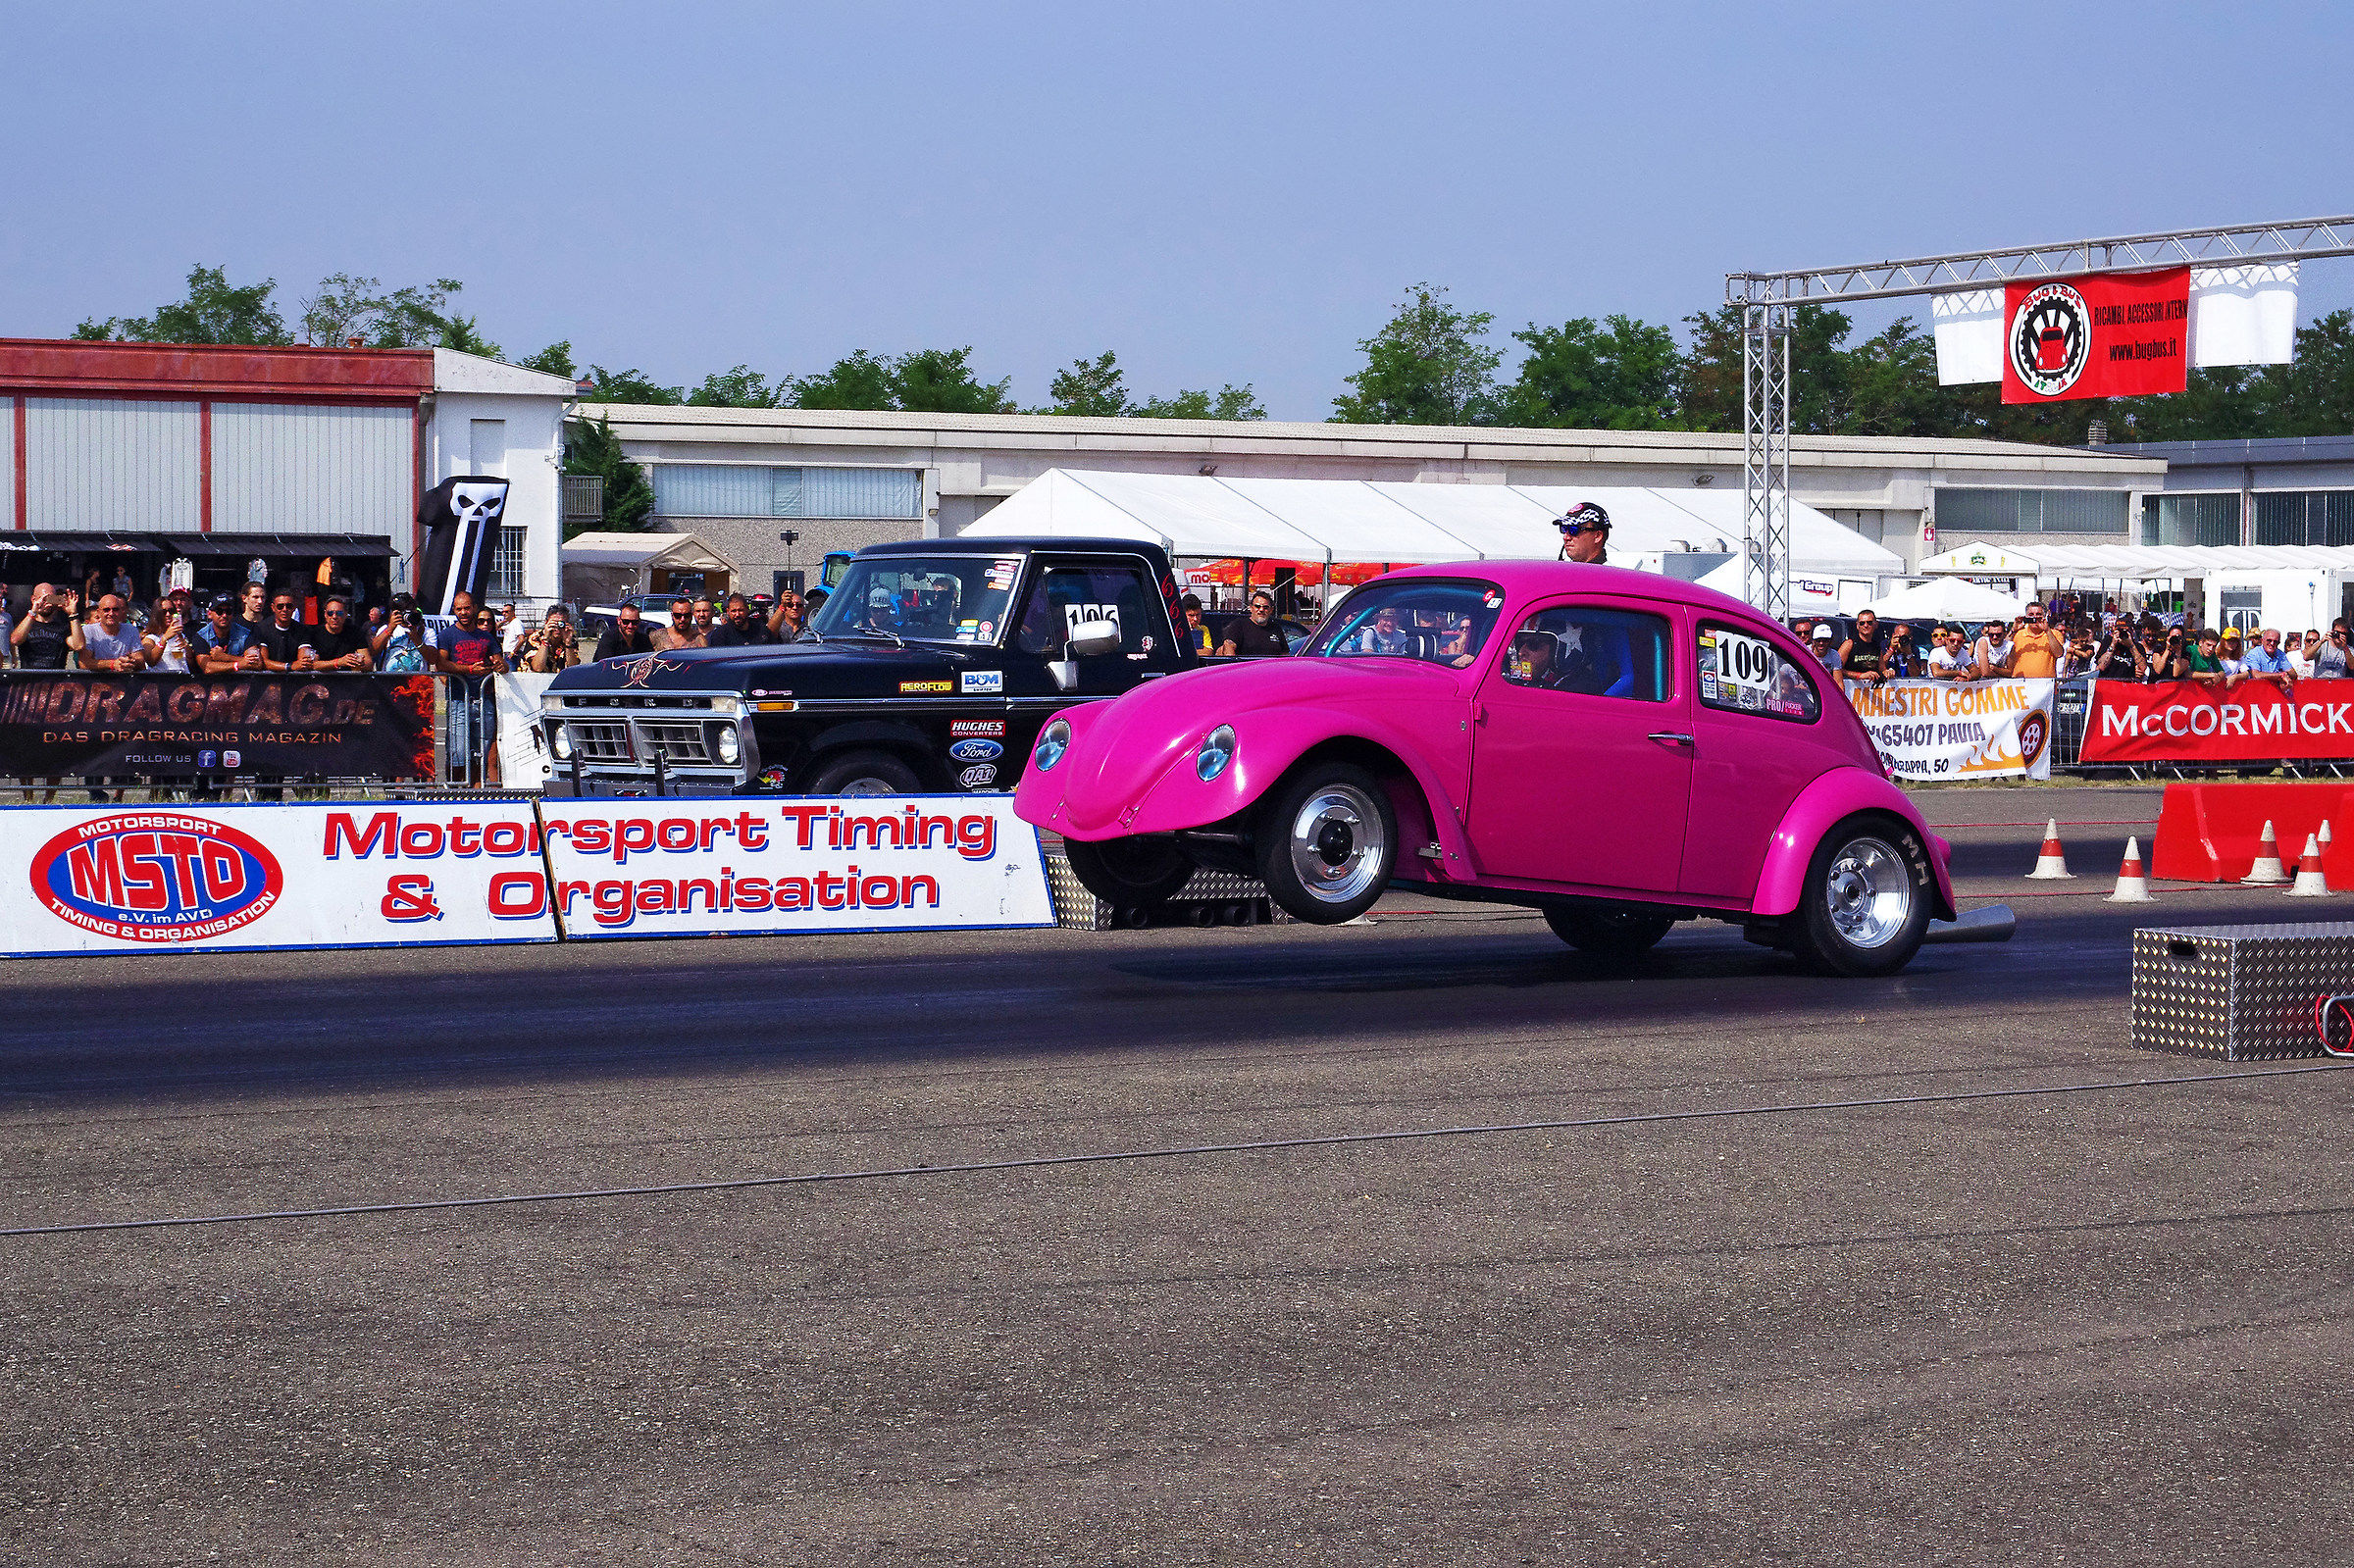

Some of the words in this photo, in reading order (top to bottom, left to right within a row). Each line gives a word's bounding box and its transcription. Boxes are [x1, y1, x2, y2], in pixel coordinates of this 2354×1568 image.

[2022, 287, 2050, 313] BUG
[2060, 284, 2082, 310] BUS
[2110, 337, 2176, 362] www.bugbus.it
[1805, 580, 1833, 593] Group
[1719, 638, 1768, 683] 109
[900, 682, 952, 692] AEROFLOW
[964, 675, 999, 685] B&M
[44, 683, 378, 725] DRAGMAG.DE
[1852, 686, 1938, 717] MAESTRI
[1945, 685, 2029, 717] GOMME
[950, 721, 1004, 732] HUGHES
[2101, 703, 2354, 736] McCORMICK
[43, 732, 89, 743] DAS
[101, 731, 238, 743] DRAGRACING
[249, 732, 341, 744] MAGAZIN
[1938, 722, 1986, 745] PAVIA
[126, 754, 172, 763] FOLLOW
[959, 742, 994, 758] Ford
[963, 766, 995, 784] QA1
[1933, 758, 1950, 774] 50
[77, 816, 222, 838] MOTORSPORT
[323, 811, 769, 865] Motorsport
[782, 804, 998, 861] Timing
[66, 832, 247, 912] MSTO
[381, 873, 445, 924] &
[488, 864, 940, 929] Organisation
[50, 896, 118, 936] TIMING
[121, 925, 136, 937] &
[138, 889, 277, 940] ORGANISATION
[118, 912, 149, 923] e.V.
[152, 913, 172, 924] im
[175, 908, 213, 923] AVD
